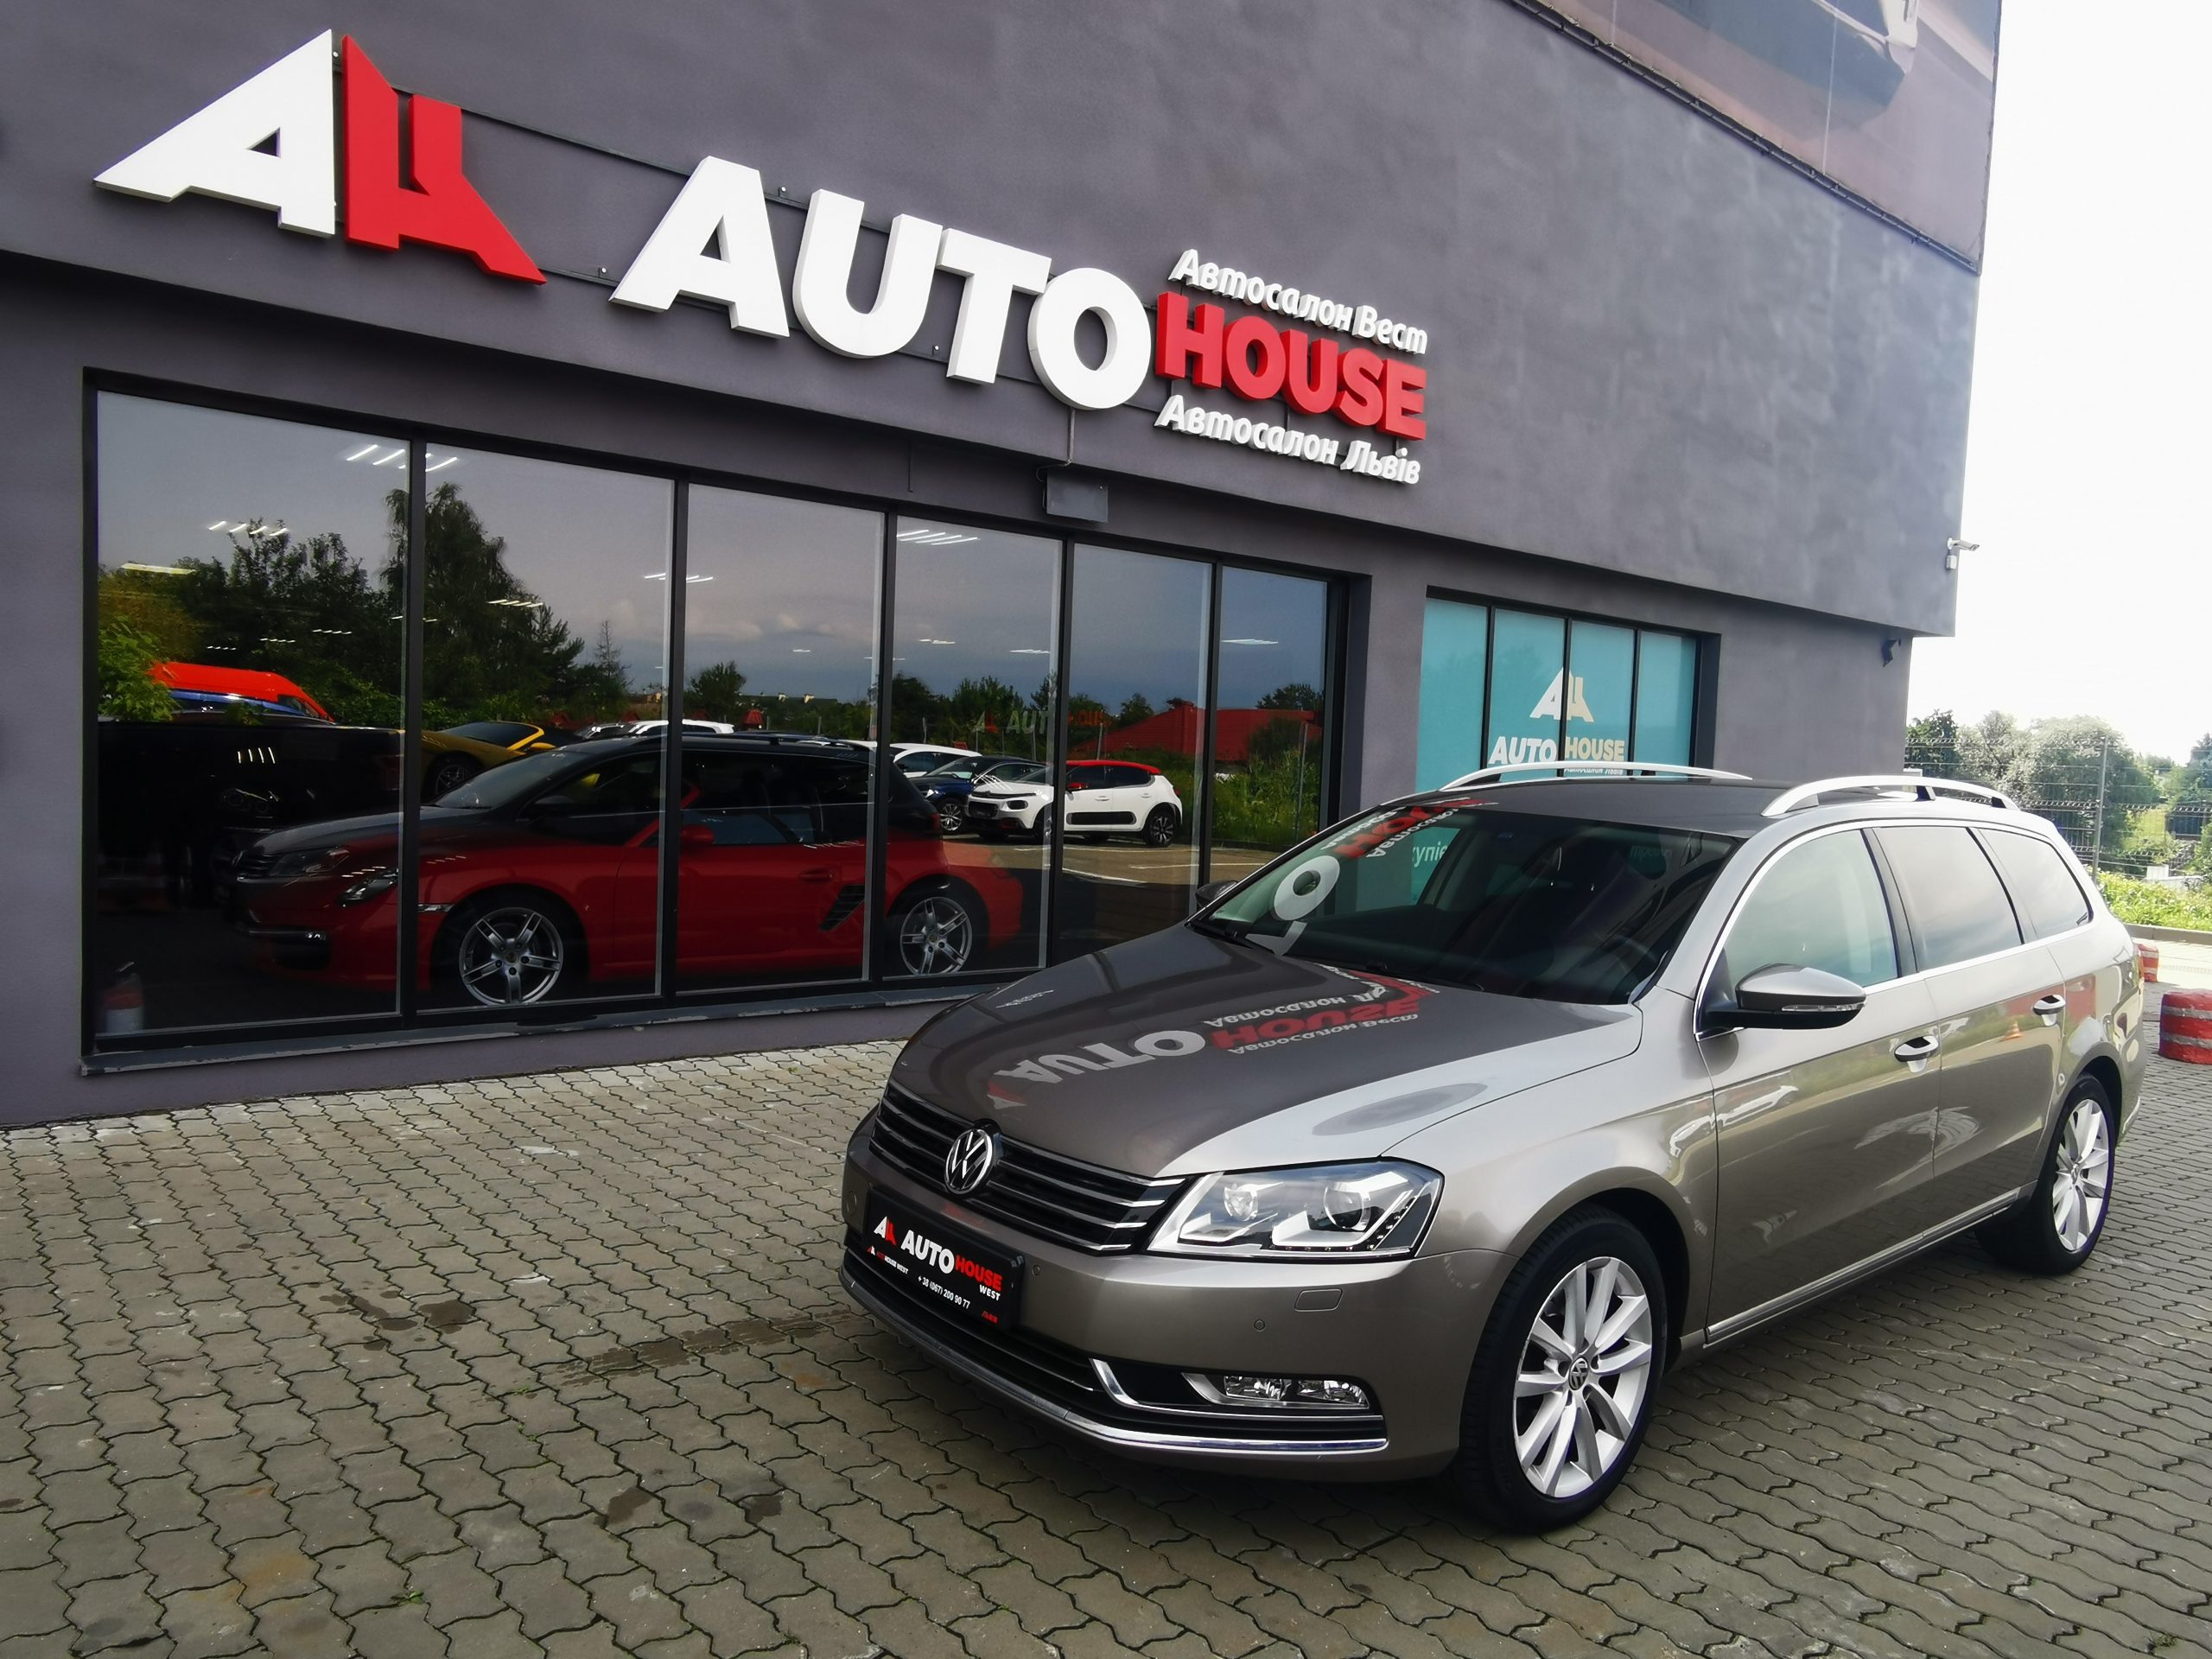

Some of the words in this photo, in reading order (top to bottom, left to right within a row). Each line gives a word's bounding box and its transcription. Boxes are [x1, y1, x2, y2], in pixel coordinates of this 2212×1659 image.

[608, 156, 1152, 410] AUTO
[1155, 291, 1427, 441] HOUSE
[1167, 248, 1354, 332] Автосалон
[1352, 304, 1428, 355] Вест
[1154, 394, 1339, 466] Автосалон
[1340, 439, 1422, 485] Львів
[1488, 736, 1558, 765] AUTO
[1564, 737, 1625, 762] HOUSE
[900, 1229, 956, 1274] AUTO
[955, 1255, 1002, 1292] HOUSE
[979, 1283, 1001, 1301] WEST
[943, 1288, 955, 1301] 200
[954, 1294, 963, 1306] 90
[963, 1298, 971, 1310] 77
